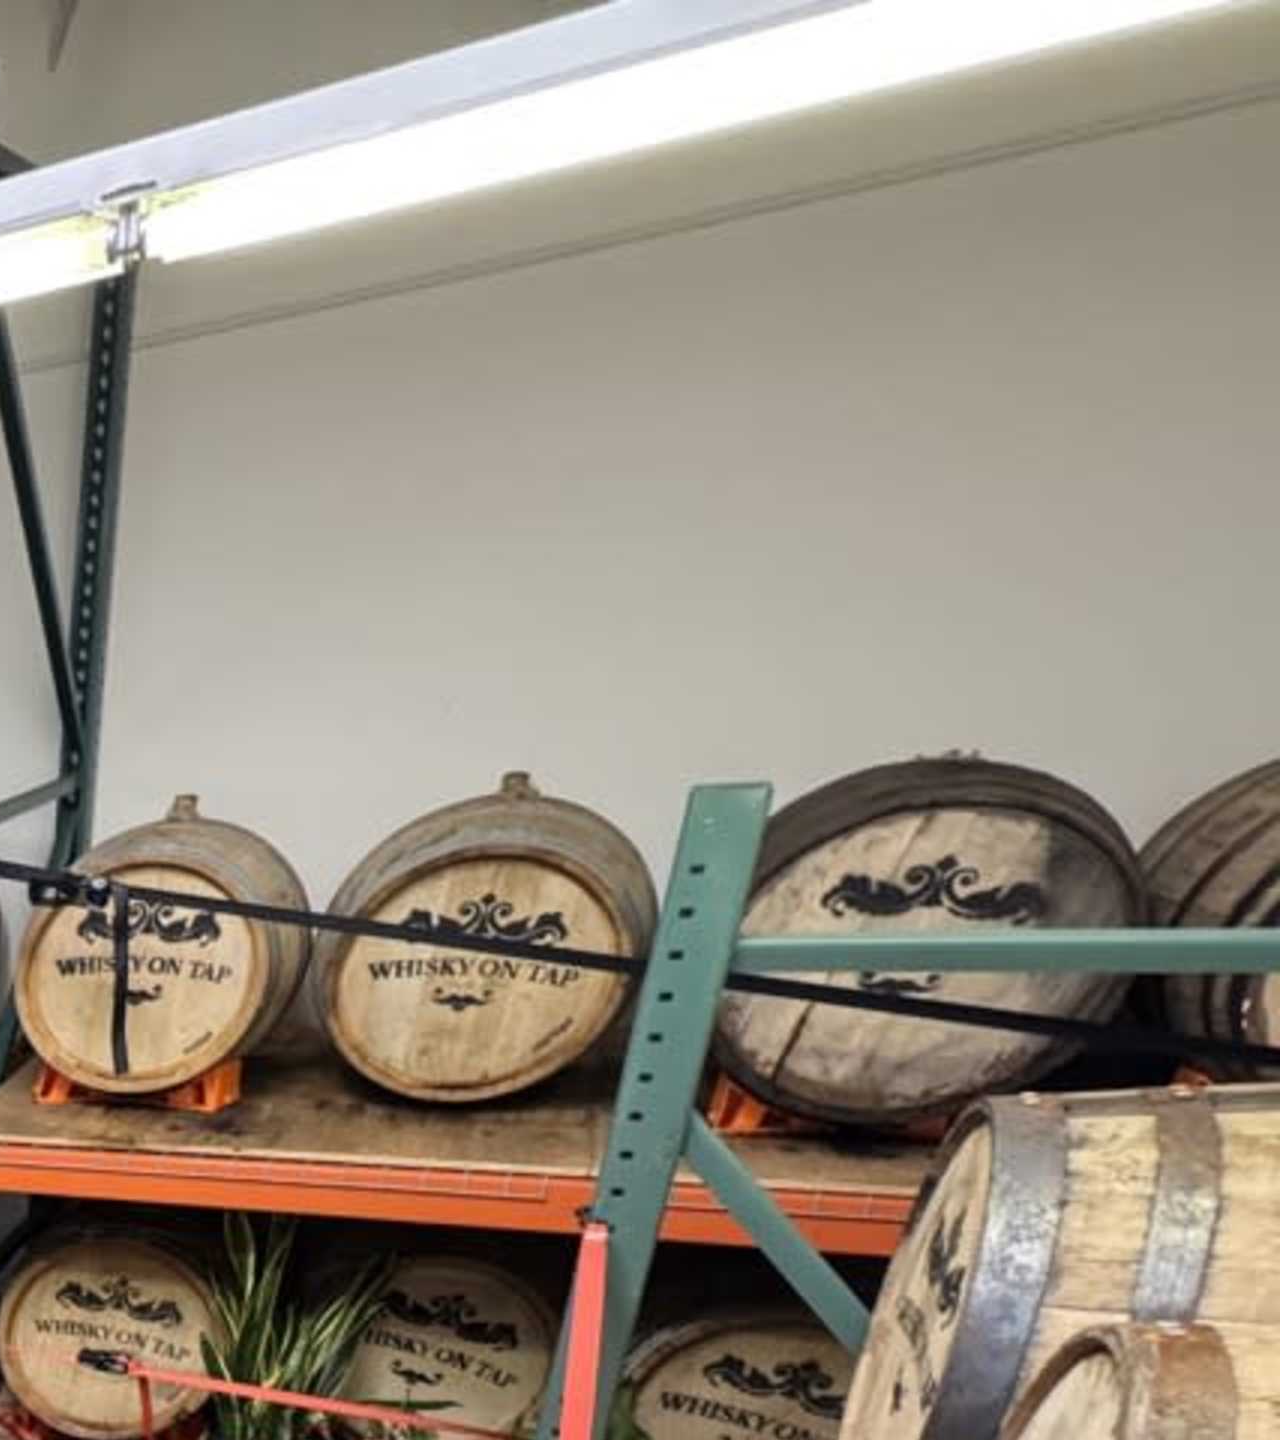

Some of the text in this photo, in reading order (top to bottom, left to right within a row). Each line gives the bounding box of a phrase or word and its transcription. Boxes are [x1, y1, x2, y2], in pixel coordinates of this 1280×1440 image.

[56, 955, 233, 984] WHISY ON TAP
[368, 958, 579, 988] WHISKY ON TAP
[34, 1319, 191, 1361] WHISKY ON TAP
[365, 1327, 518, 1388] HISKY ON TAP
[659, 1391, 776, 1433] WHISKY
